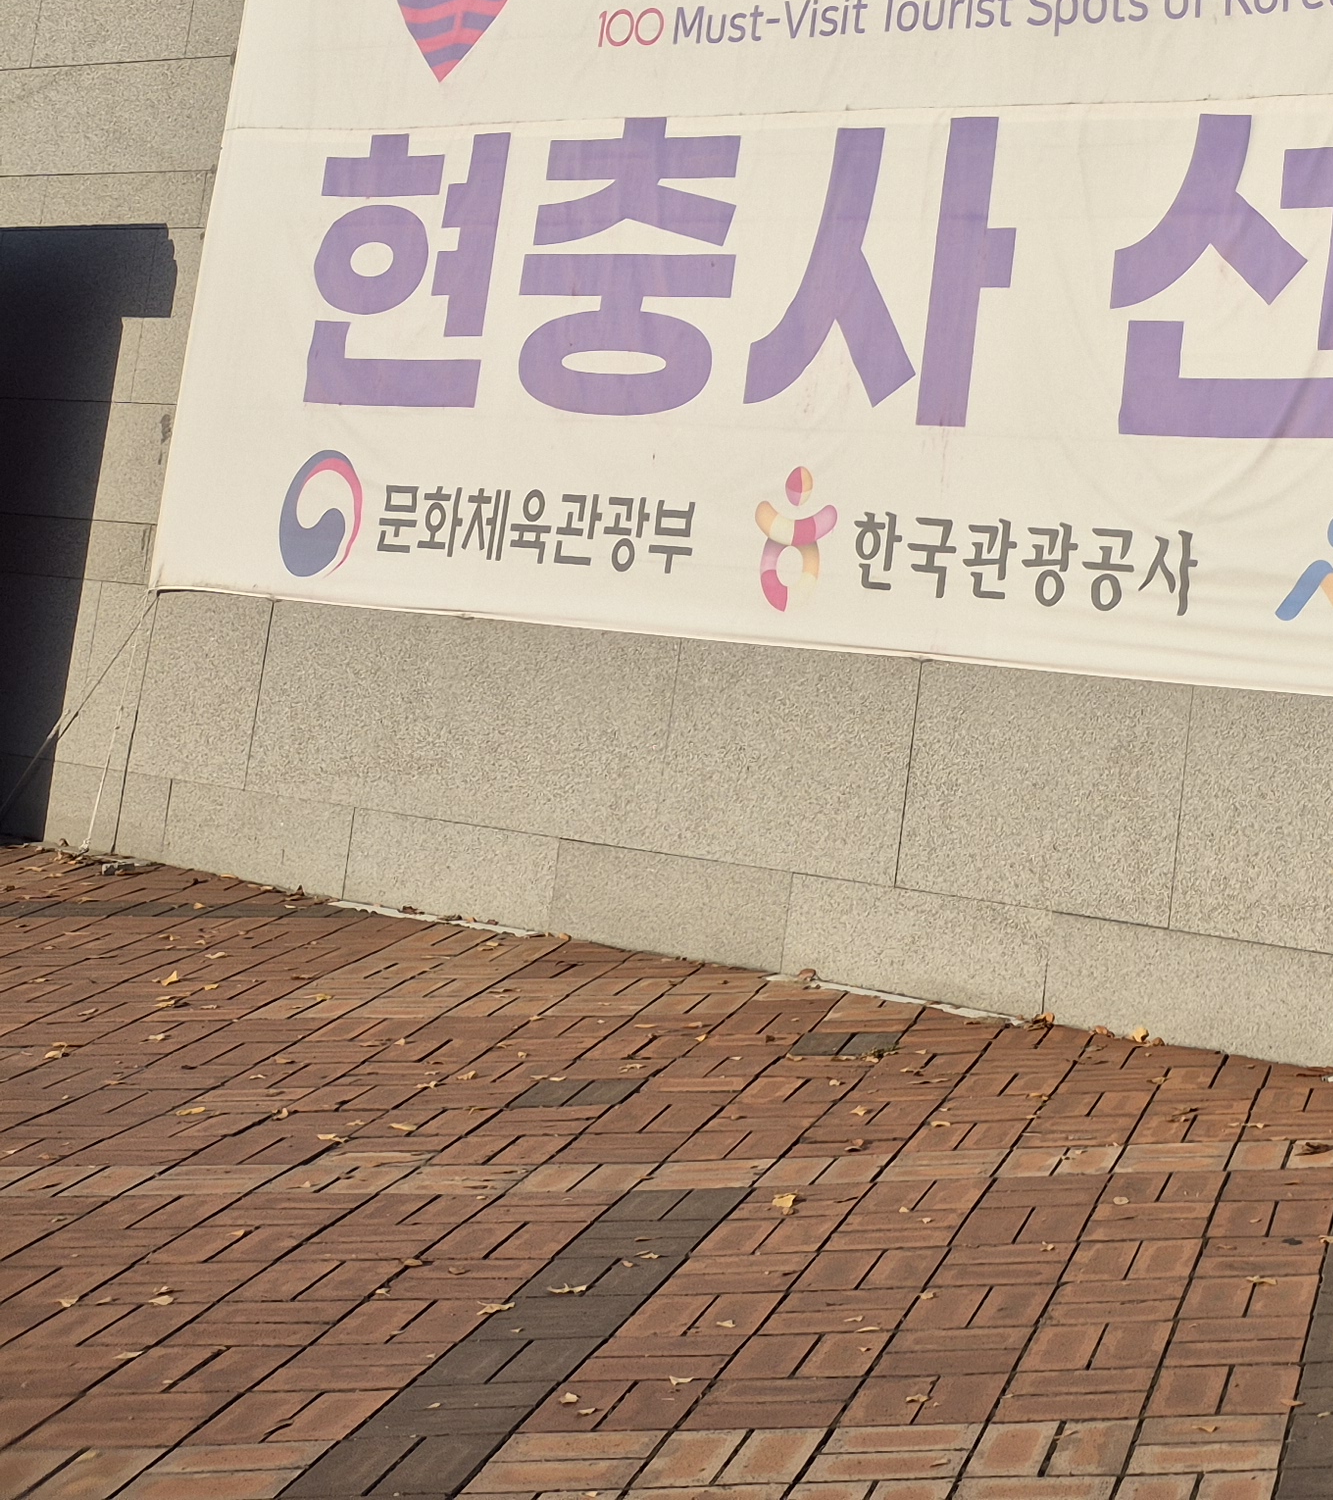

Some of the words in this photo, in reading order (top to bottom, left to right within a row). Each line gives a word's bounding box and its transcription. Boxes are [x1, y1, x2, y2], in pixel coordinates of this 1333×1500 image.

[596, 6, 665, 48] 100
[303, 115, 1017, 428] 현충사
[375, 483, 696, 575] 문화체육관광부
[853, 510, 1199, 617] 한국관광공사
